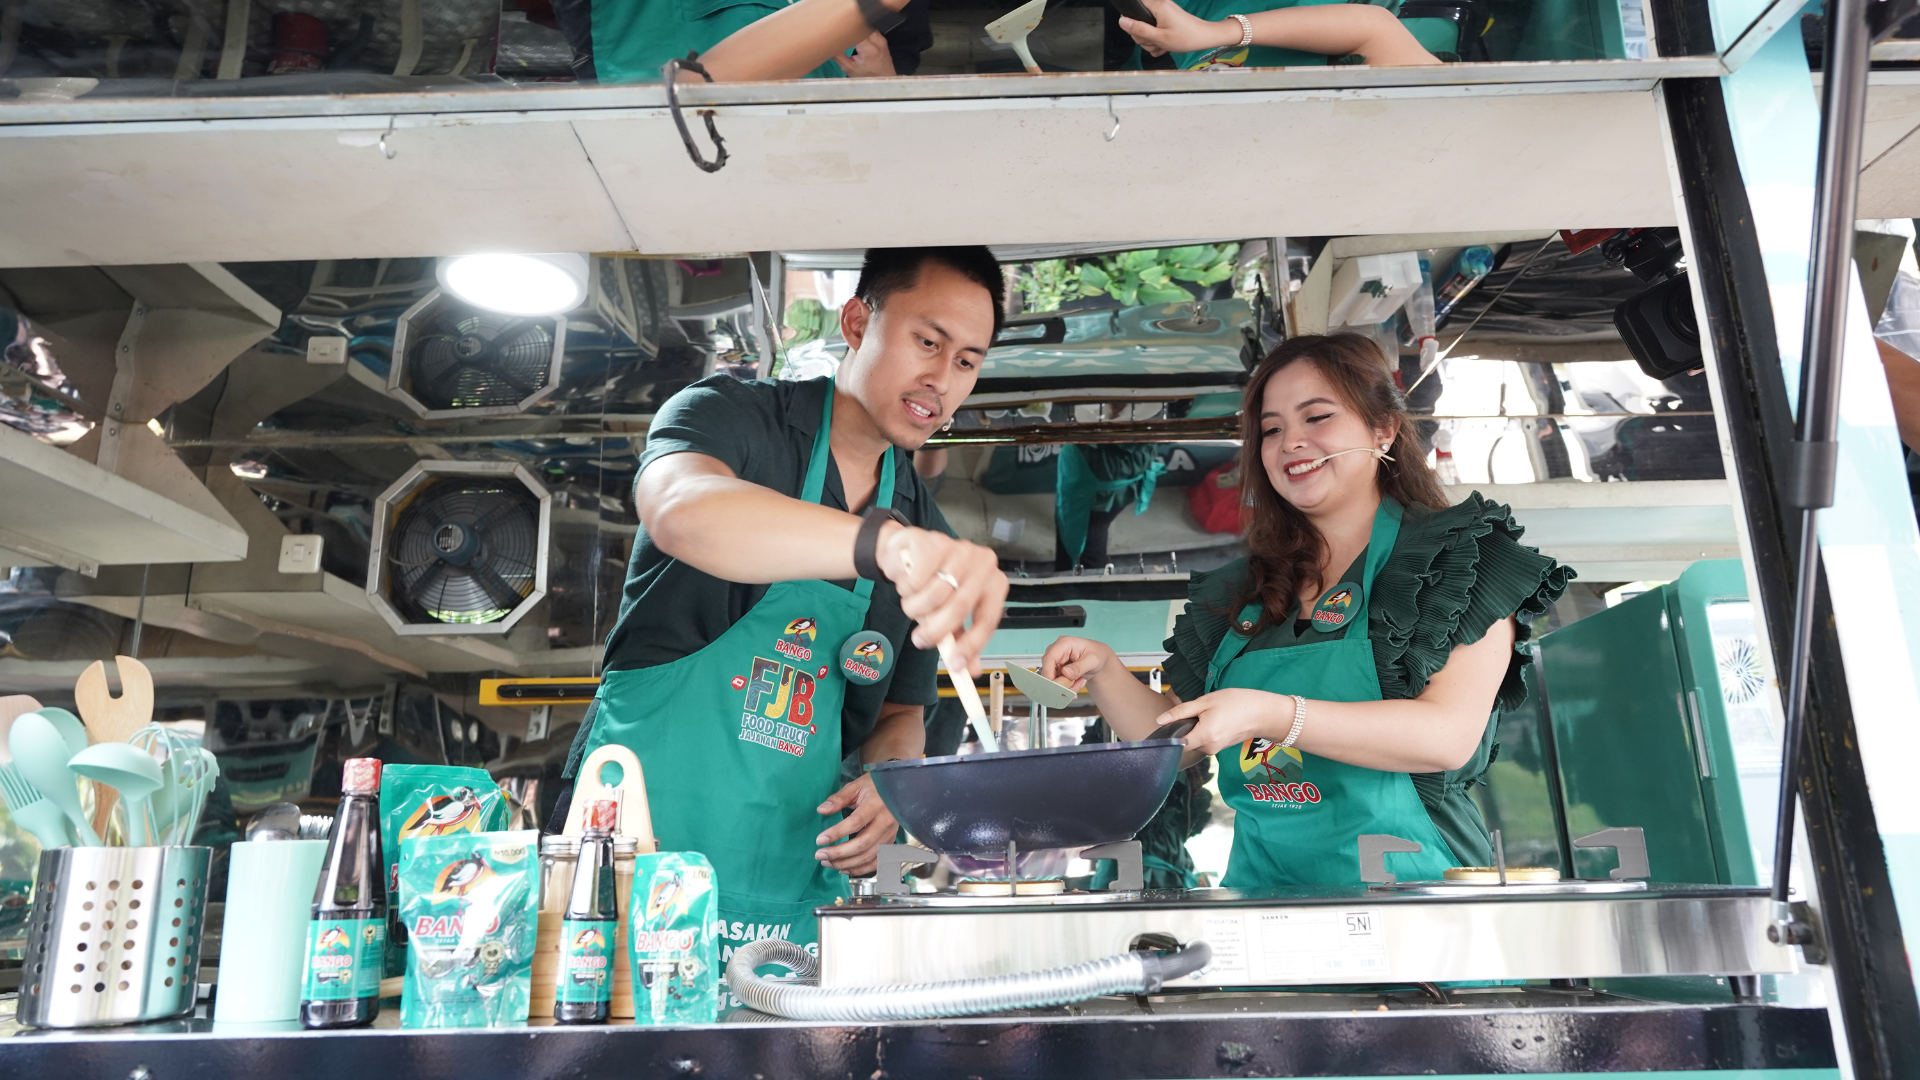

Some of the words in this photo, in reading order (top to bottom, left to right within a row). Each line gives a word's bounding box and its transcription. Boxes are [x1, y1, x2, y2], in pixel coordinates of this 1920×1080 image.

[1313, 610, 1344, 624] BANGO
[775, 639, 812, 661] BANGO
[844, 658, 879, 680] BANGO
[744, 656, 816, 726] FJB
[741, 712, 774, 735] FOOD
[775, 721, 809, 746] TRUCK
[739, 728, 777, 750] JAJANAN
[777, 740, 805, 758] BANGO
[1244, 782, 1321, 804] BANGO
[414, 915, 501, 938] BANO
[1346, 916, 1371, 932] SNI
[635, 930, 694, 952] BANGO
[311, 955, 353, 968] BANGO
[568, 955, 607, 968] BANGO
